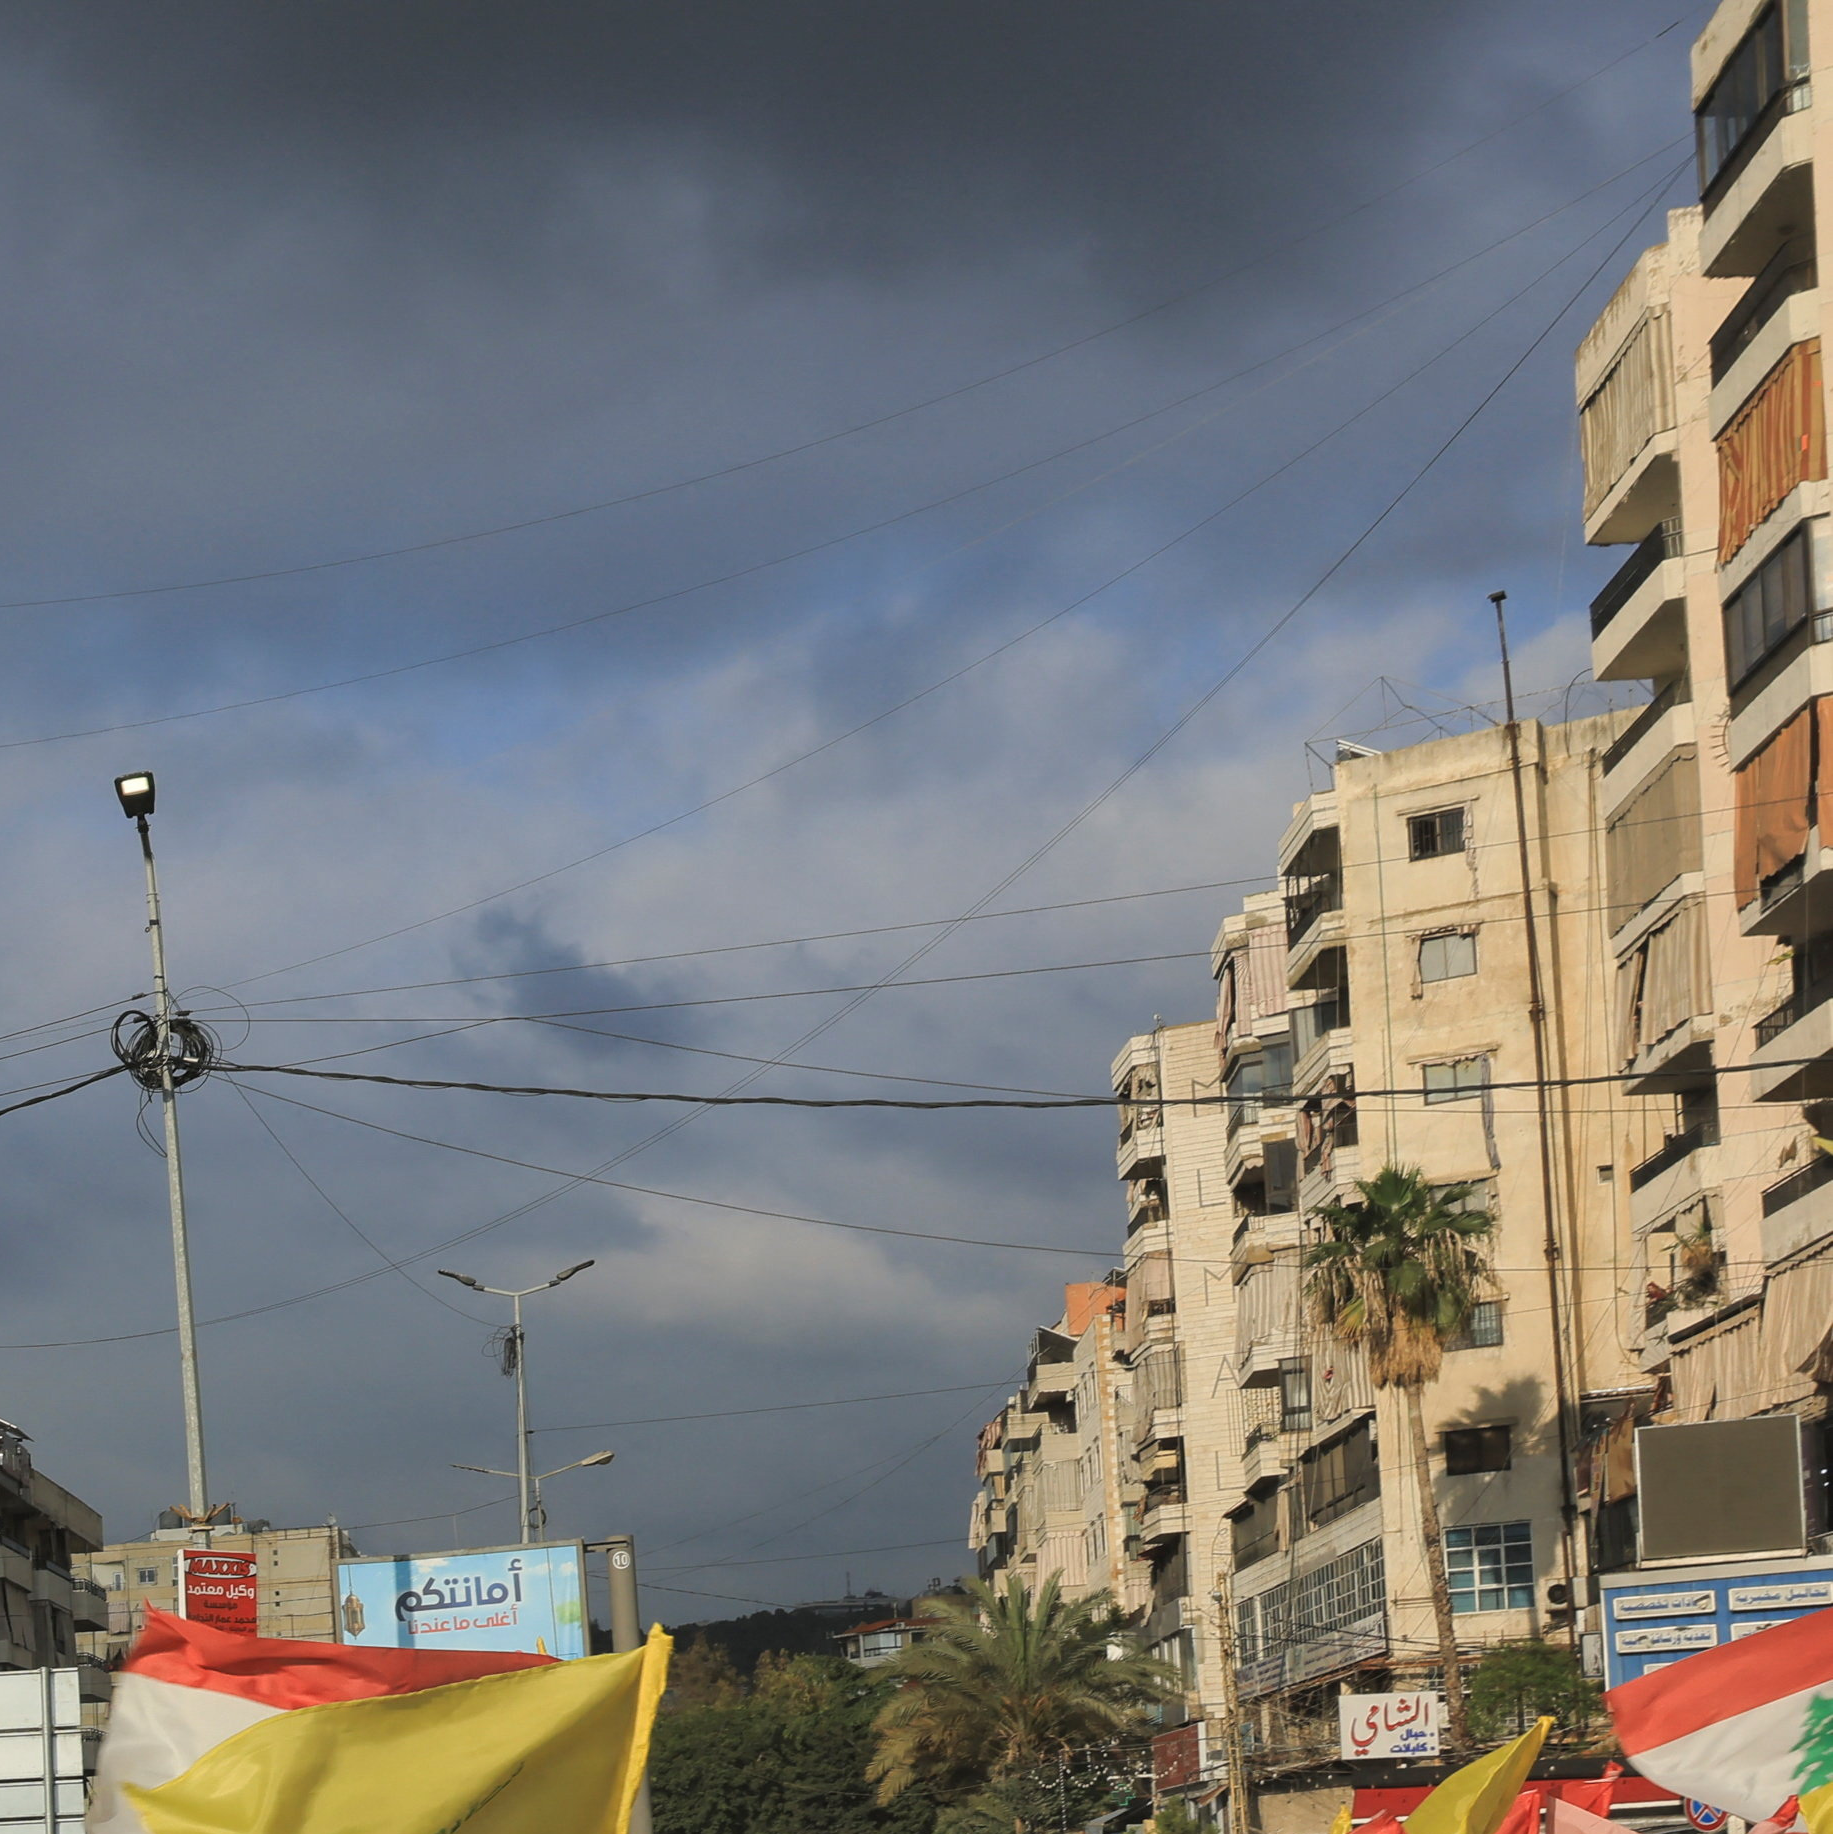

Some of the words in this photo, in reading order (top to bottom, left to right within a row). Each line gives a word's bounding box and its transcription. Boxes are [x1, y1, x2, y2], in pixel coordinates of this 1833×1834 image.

[614, 1553, 629, 1567] 10
[187, 1582, 224, 1596] معتمد
[226, 1584, 255, 1600] وكيل
[395, 1558, 523, 1622] أمانتكم
[1785, 1587, 1829, 1602] تحاليل
[1735, 1591, 1781, 1605] مخبرية
[1619, 1600, 1670, 1613] تخصصية
[453, 1615, 470, 1631] ما
[473, 1603, 518, 1630] أغلى
[407, 1617, 452, 1636] عندنا
[1350, 1695, 1430, 1757] الشامي
[1399, 1728, 1428, 1741] حبال
